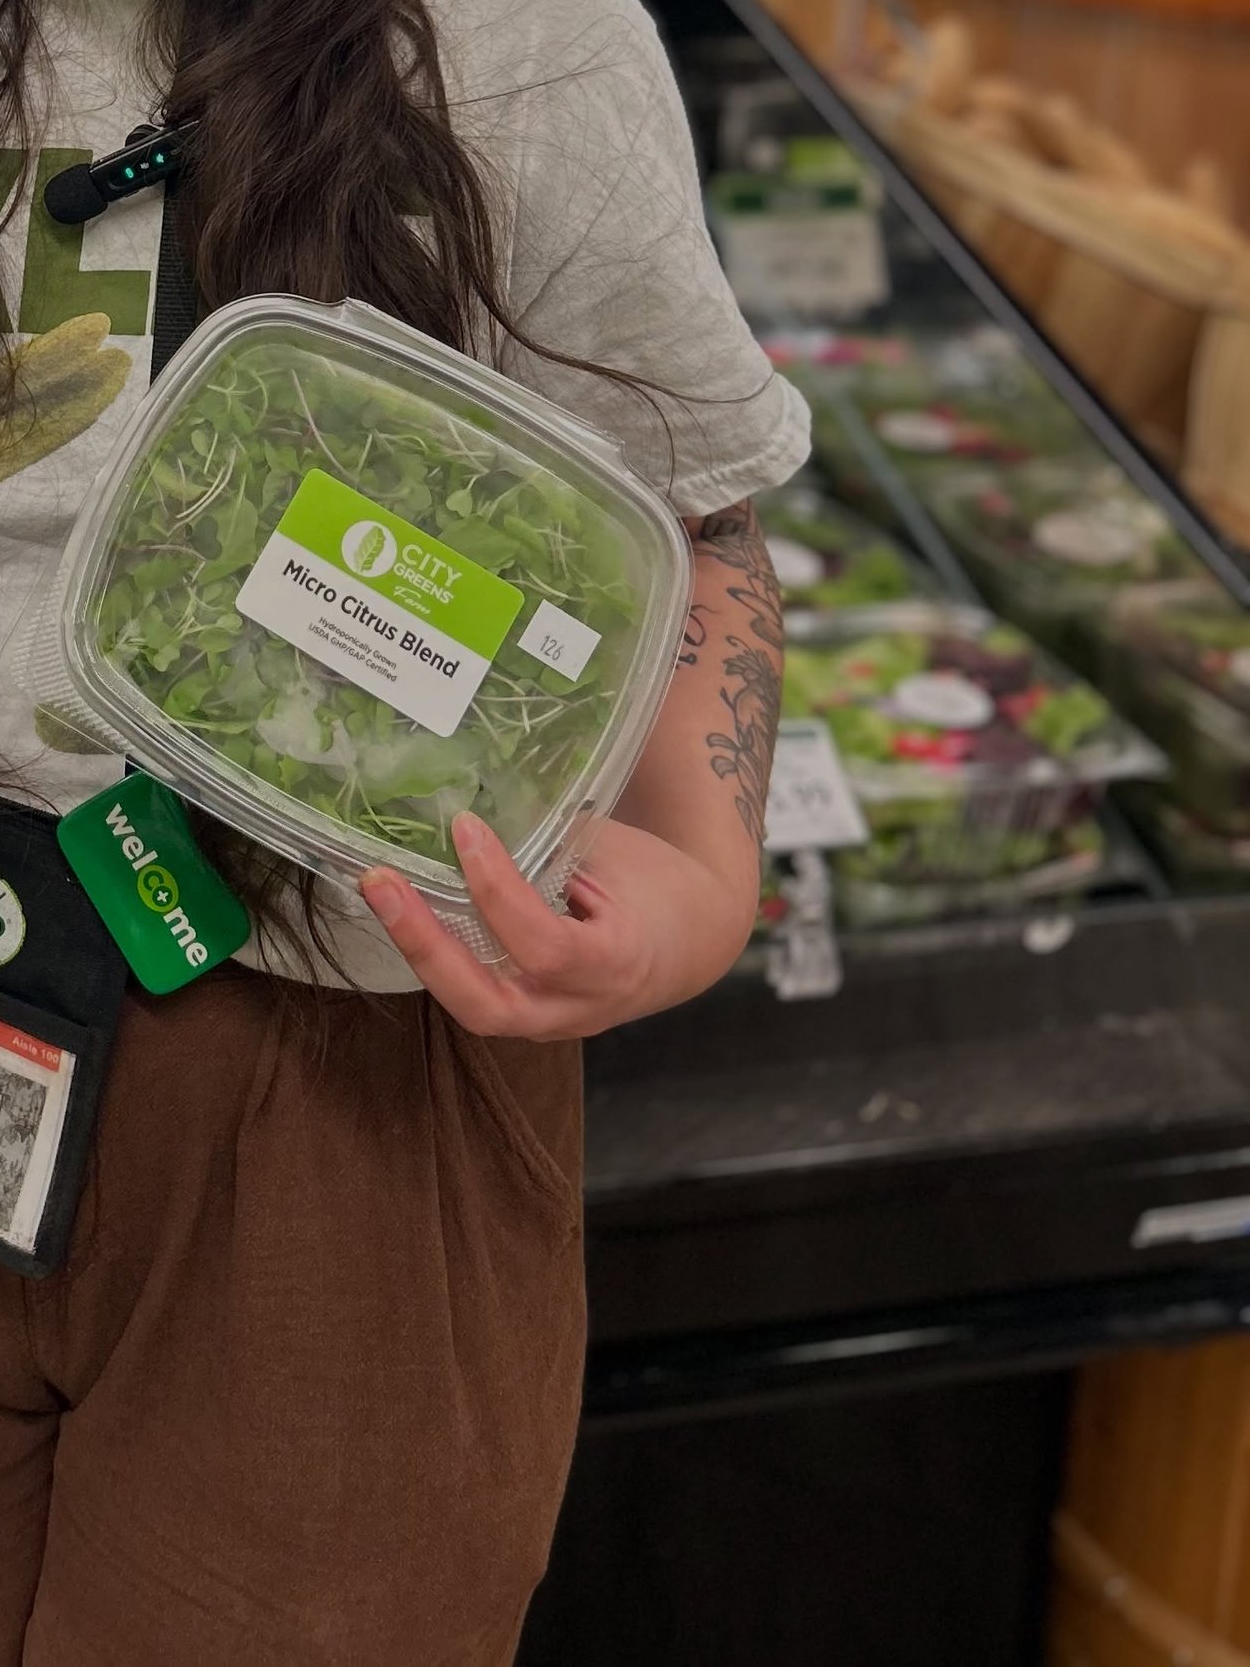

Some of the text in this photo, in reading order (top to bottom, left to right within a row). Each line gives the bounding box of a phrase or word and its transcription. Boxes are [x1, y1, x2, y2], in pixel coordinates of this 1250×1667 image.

[393, 563, 454, 604] GREENS
[402, 544, 463, 587] CITY
[282, 559, 460, 678] Micro Citrus Blend
[393, 586, 431, 614] Farm
[308, 623, 397, 682] USDA GHP/GAP Certified
[318, 617, 397, 669] Hydroponically Grown
[539, 635, 564, 661] 126
[105, 803, 208, 967] welcome
[41, 1049, 59, 1064] 100
